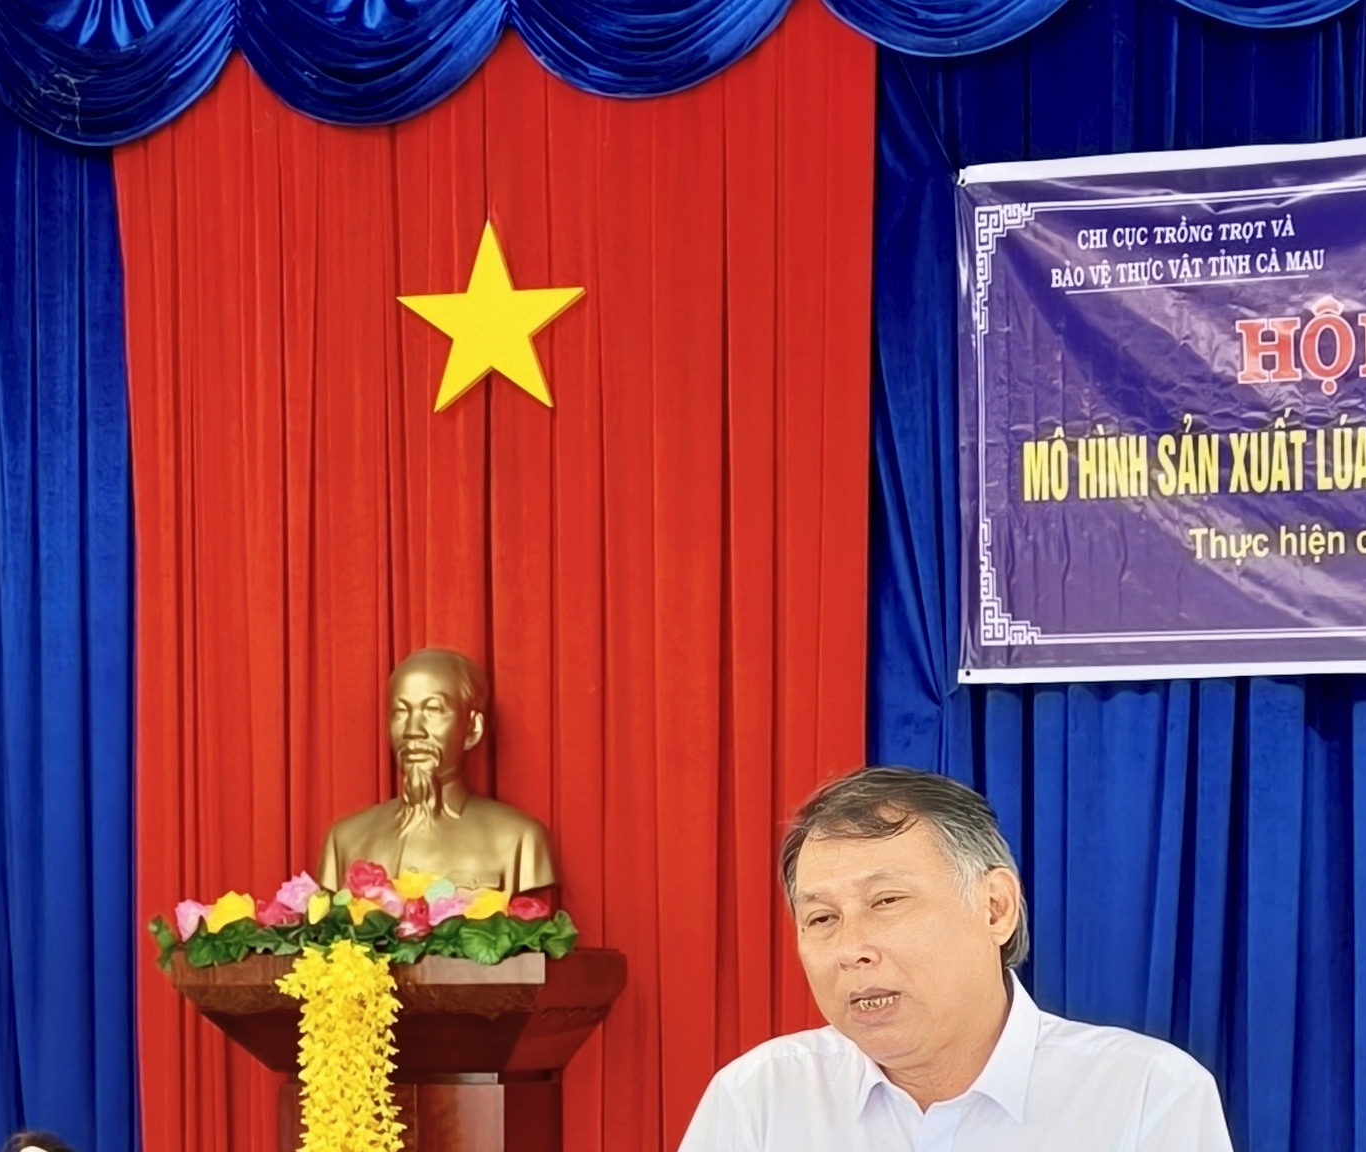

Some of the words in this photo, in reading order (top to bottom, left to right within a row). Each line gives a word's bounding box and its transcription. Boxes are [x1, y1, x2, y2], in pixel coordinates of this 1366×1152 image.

[1077, 229, 1108, 249] CHI
[1113, 226, 1148, 251] CỤC
[1218, 221, 1266, 243] TRỌT
[1089, 259, 1112, 289] VỆ
[1116, 257, 1164, 285] THỰC
[1168, 253, 1203, 282] VẬT
[1286, 249, 1325, 271] MAU
[1023, 430, 1069, 501] MÔ
[1077, 423, 1148, 499] HÌNH
[1157, 413, 1220, 496] SẢN
[1229, 408, 1307, 494] XUẤT
[1189, 526, 1270, 565] Thực
[1280, 523, 1345, 563] hiện
